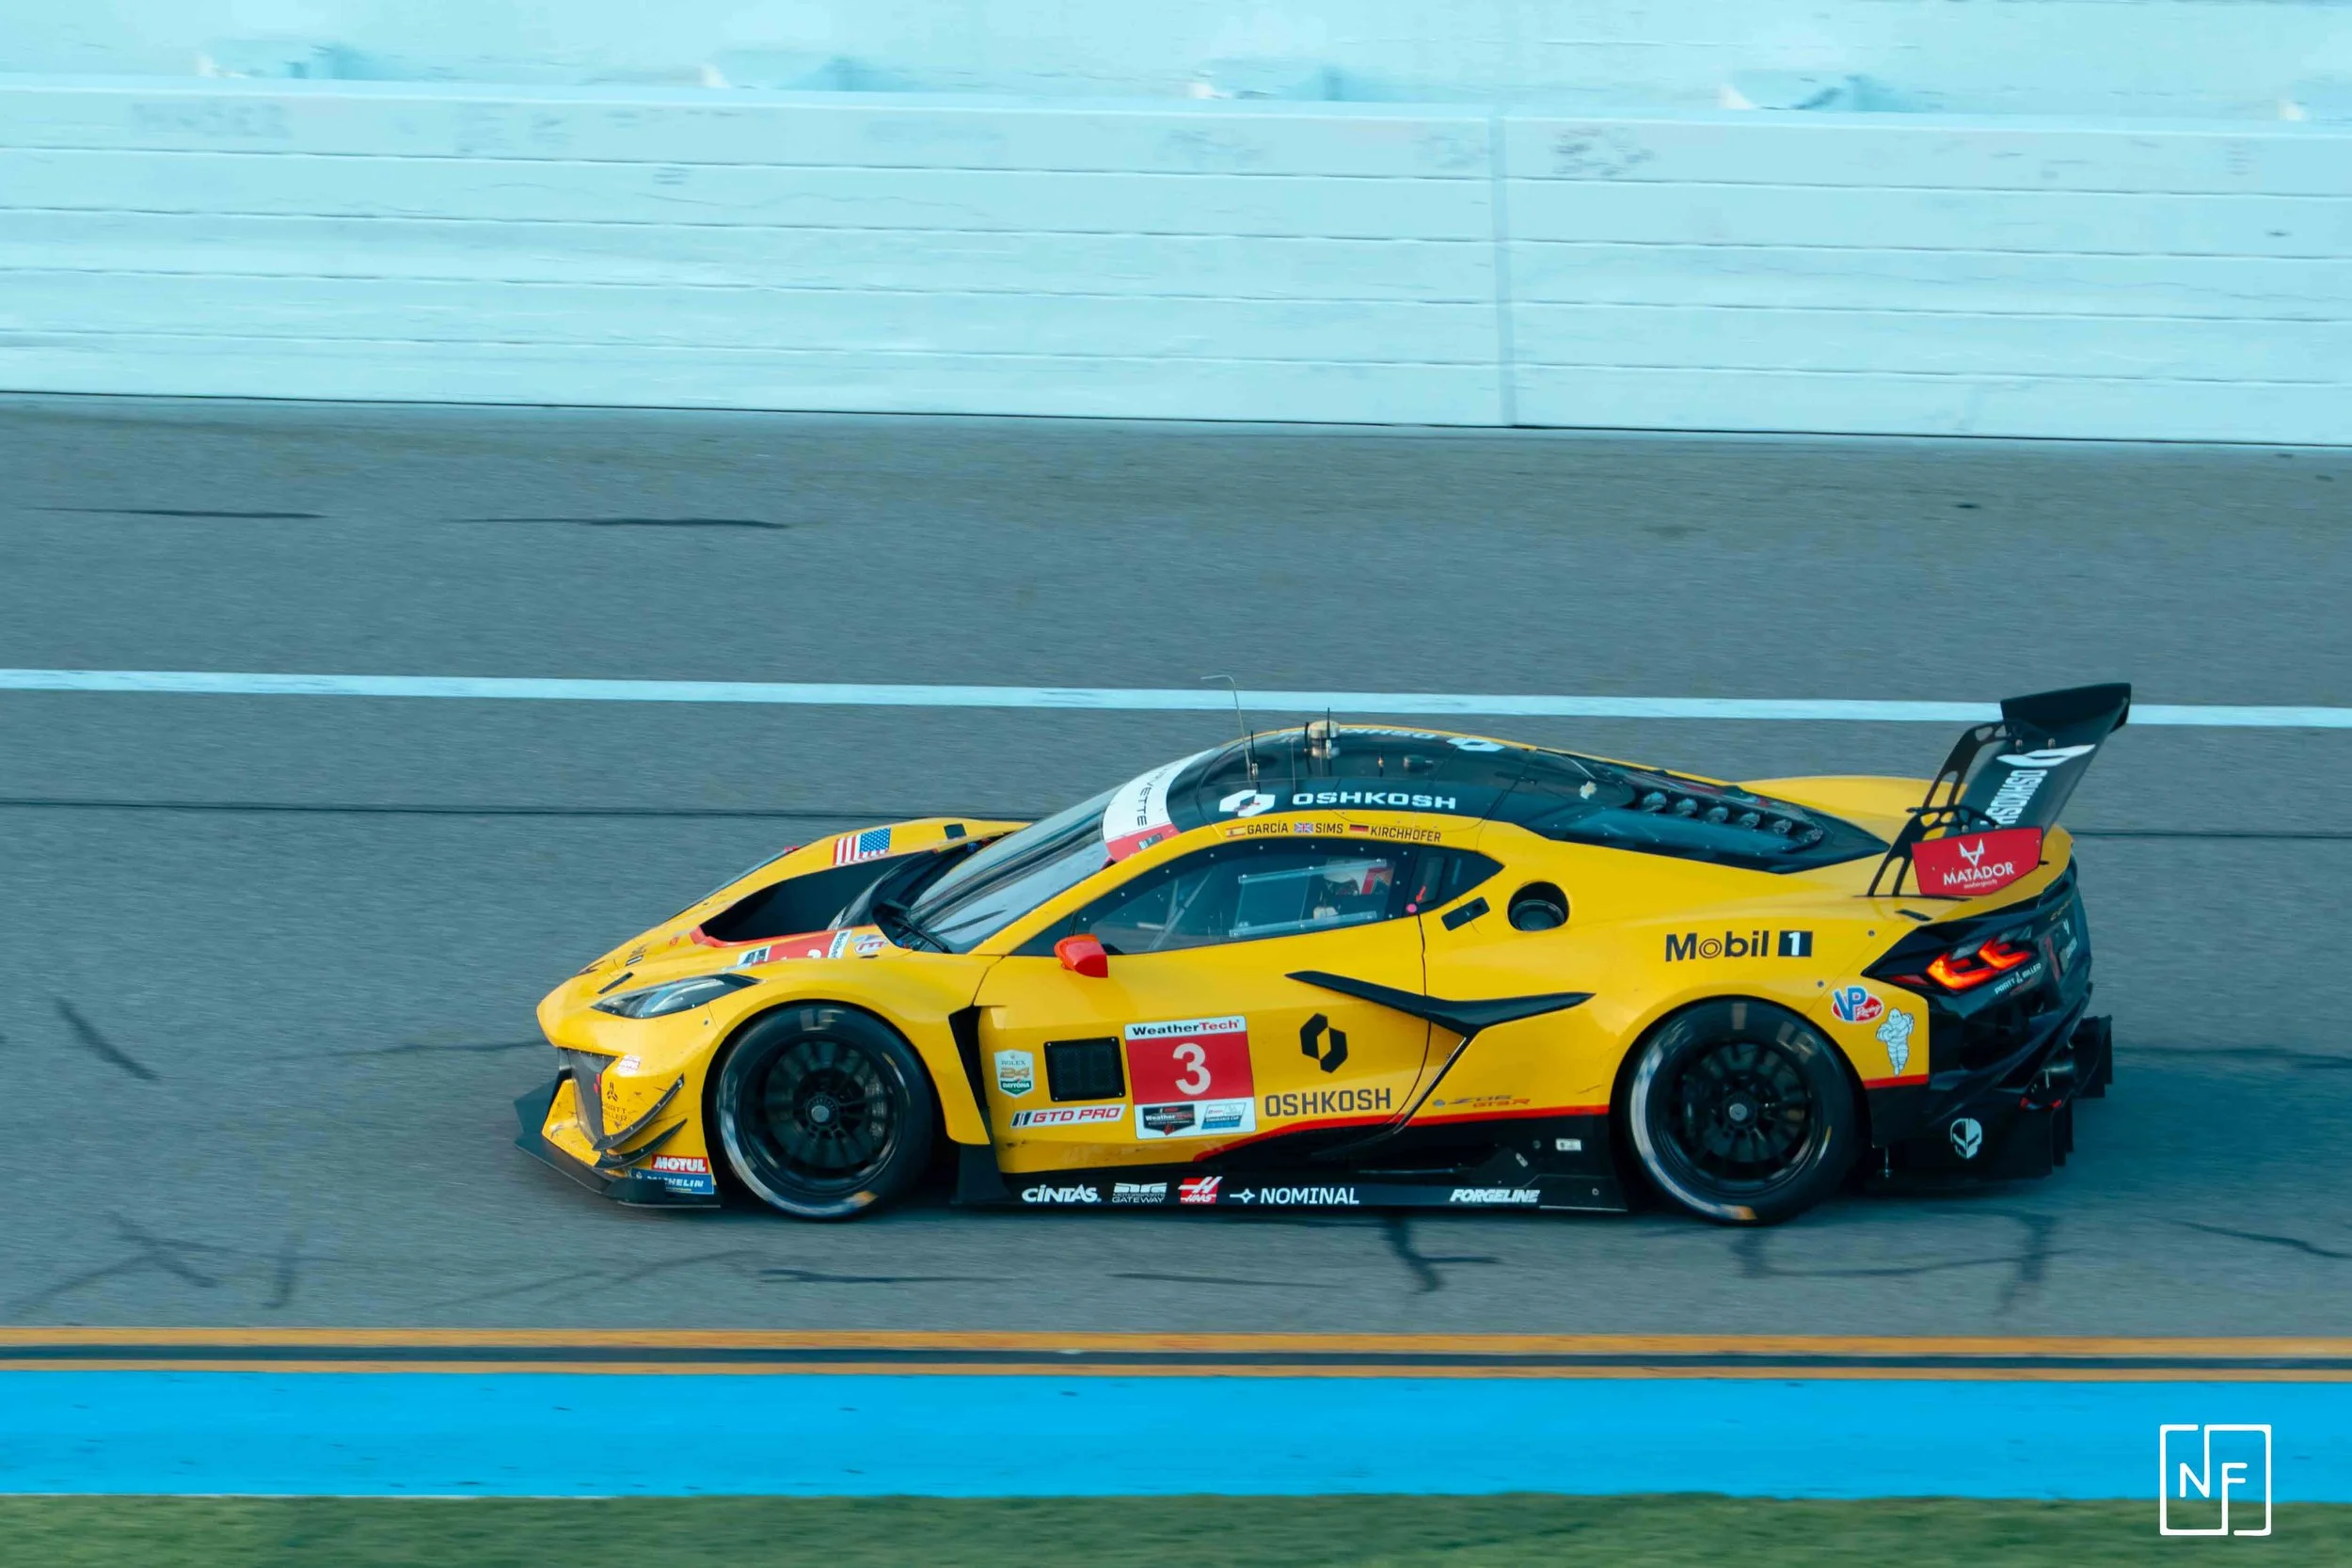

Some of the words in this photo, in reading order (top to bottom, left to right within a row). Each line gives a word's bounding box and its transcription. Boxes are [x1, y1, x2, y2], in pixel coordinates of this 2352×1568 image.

[1292, 791, 1456, 810] OSHKOSH
[1247, 820, 1289, 835] GARCÍA
[1315, 823, 1344, 834] SIMS
[1370, 827, 1441, 843] KIRCHHOFER
[1943, 862, 2014, 886] MATADOR
[1664, 930, 1769, 962] Mobil
[1788, 931, 1801, 957] 1
[1833, 987, 1867, 1022] VP
[1172, 1042, 1212, 1095] 3
[1264, 1087, 1391, 1117] OSHKOSH
[1032, 1108, 1075, 1123] GTD
[1077, 1106, 1121, 1120] PRO
[653, 1156, 706, 1172] MOTUL
[1260, 1187, 1359, 1205] NOMINAL
[1450, 1188, 1541, 1203] FORGELINE
